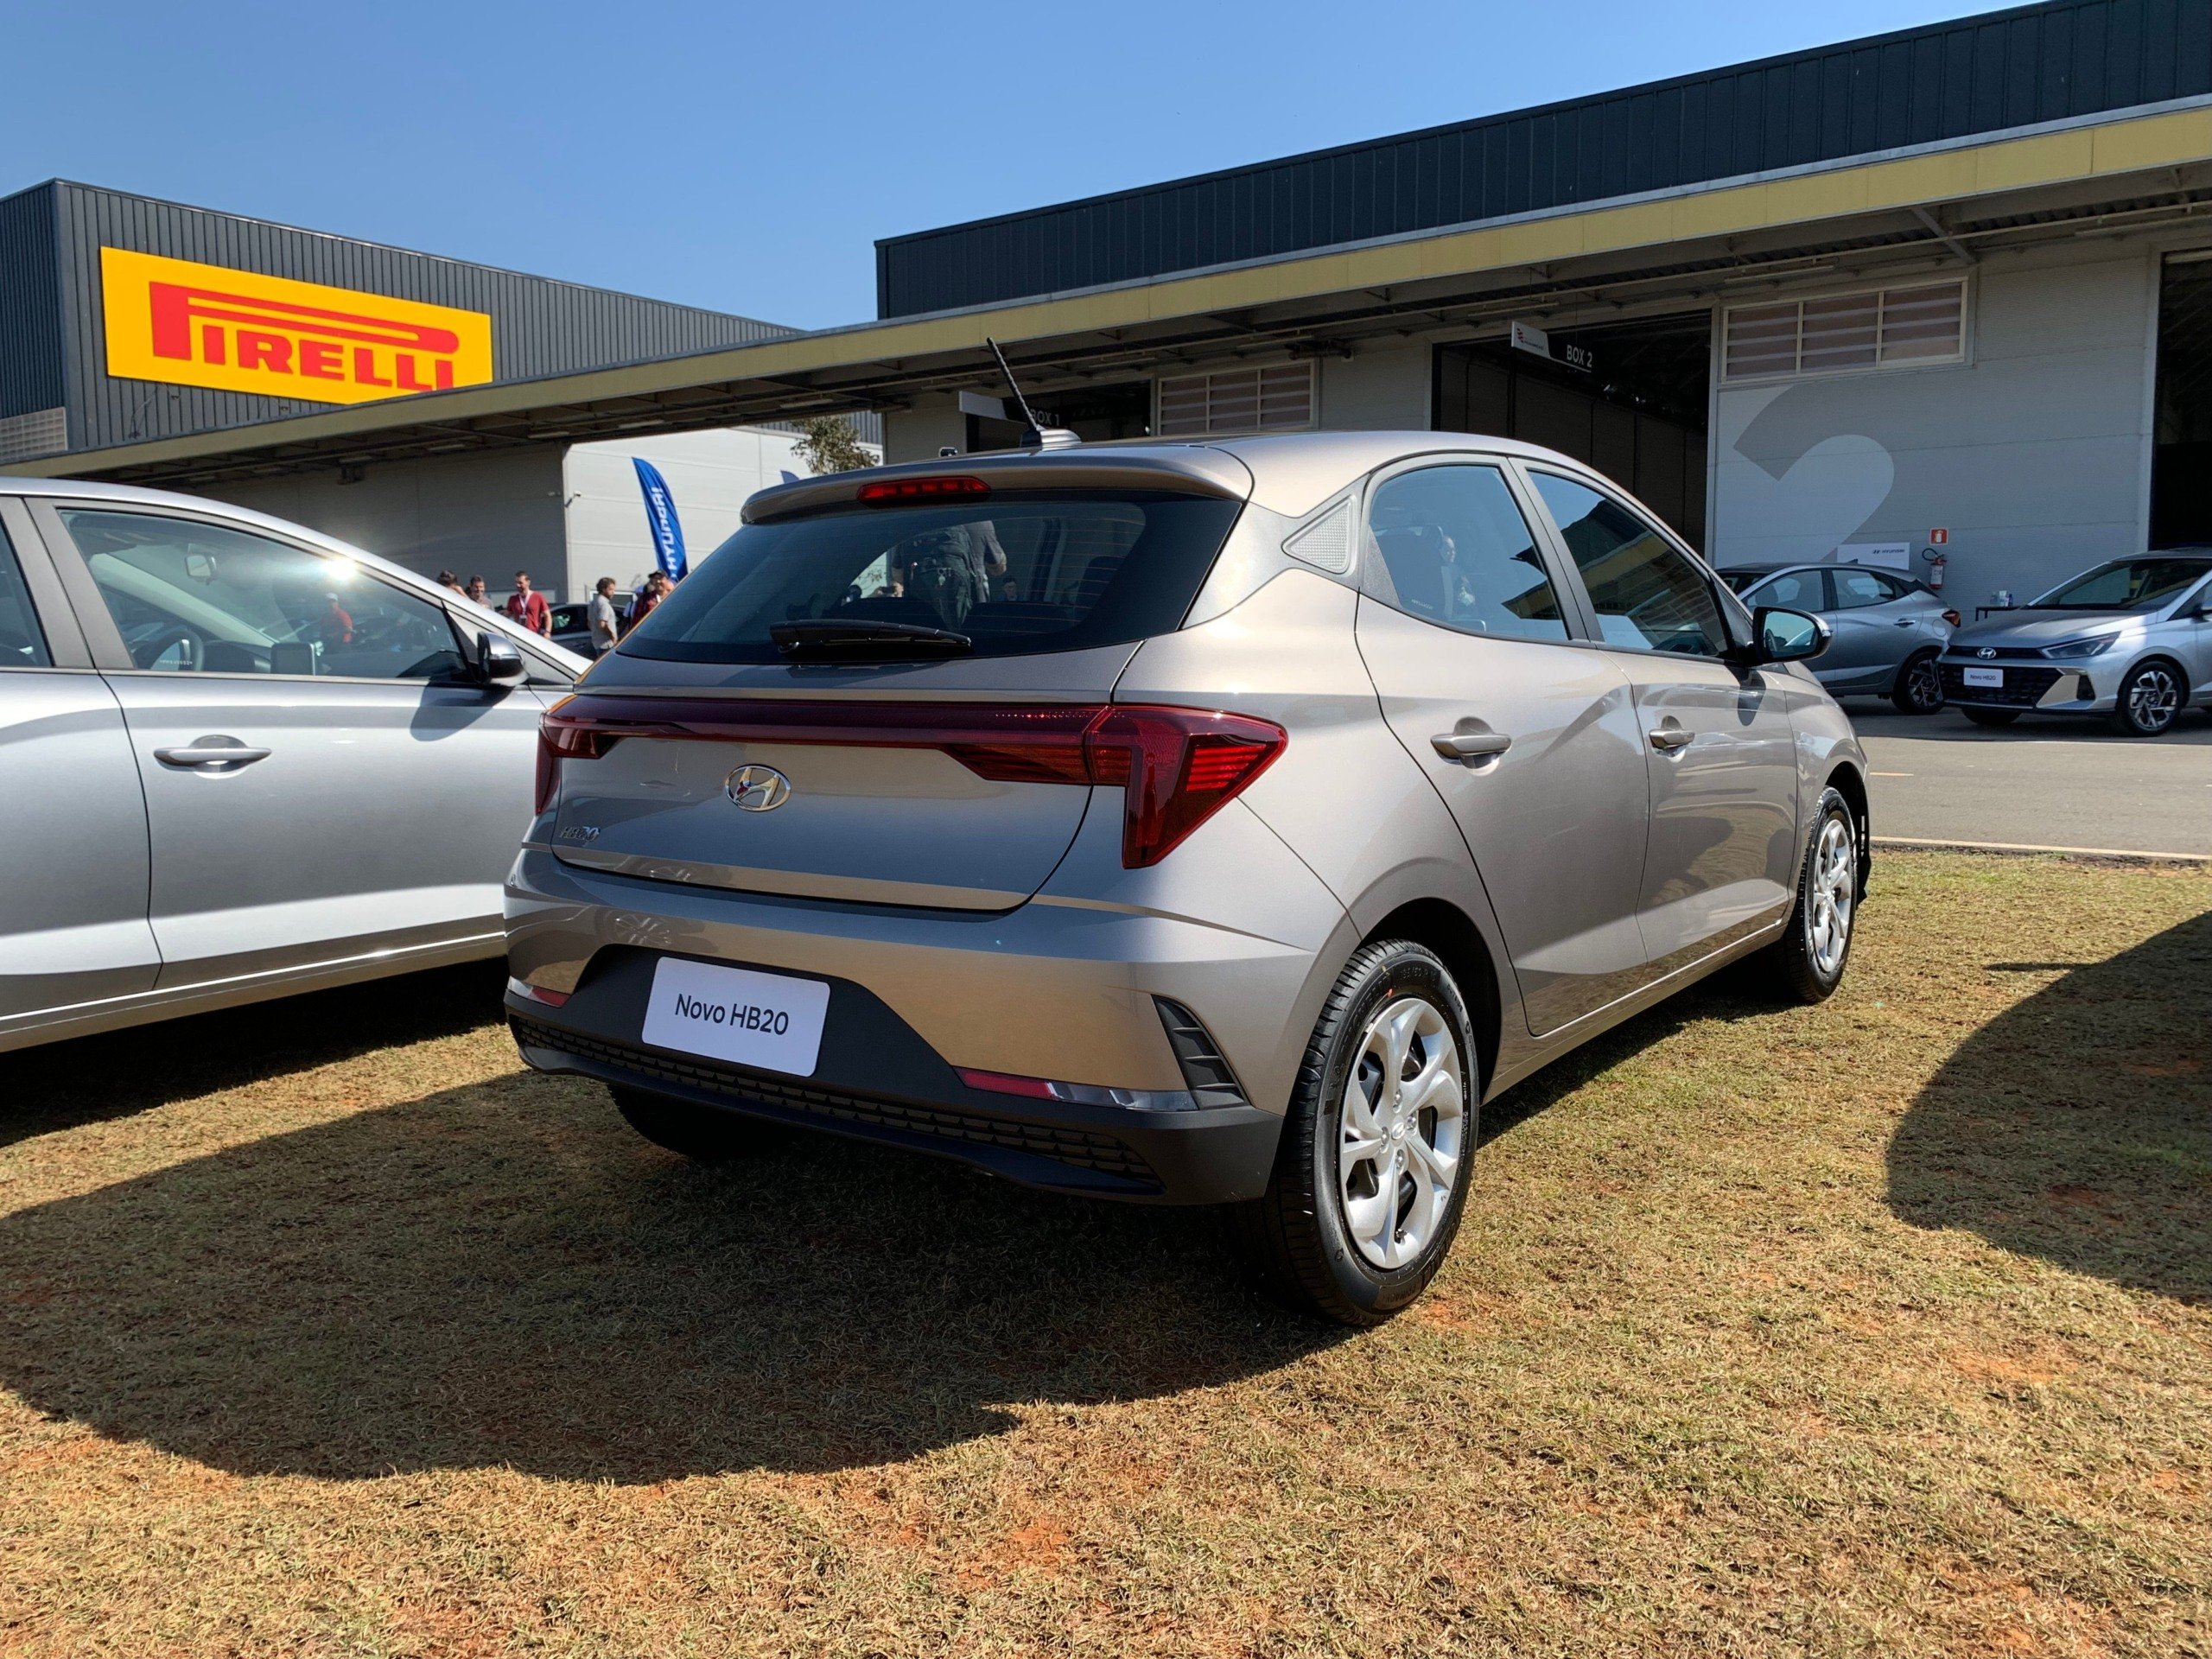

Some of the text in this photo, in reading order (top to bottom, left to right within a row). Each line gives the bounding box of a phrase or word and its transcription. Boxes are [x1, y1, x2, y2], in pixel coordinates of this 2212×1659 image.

[149, 281, 460, 393] PIRELLI
[1567, 344, 1585, 365] BOX
[1586, 352, 1592, 368] 2
[1055, 414, 1060, 426] 1
[651, 486, 677, 570] HYUNDAI
[675, 994, 789, 1036] Novo HB20
